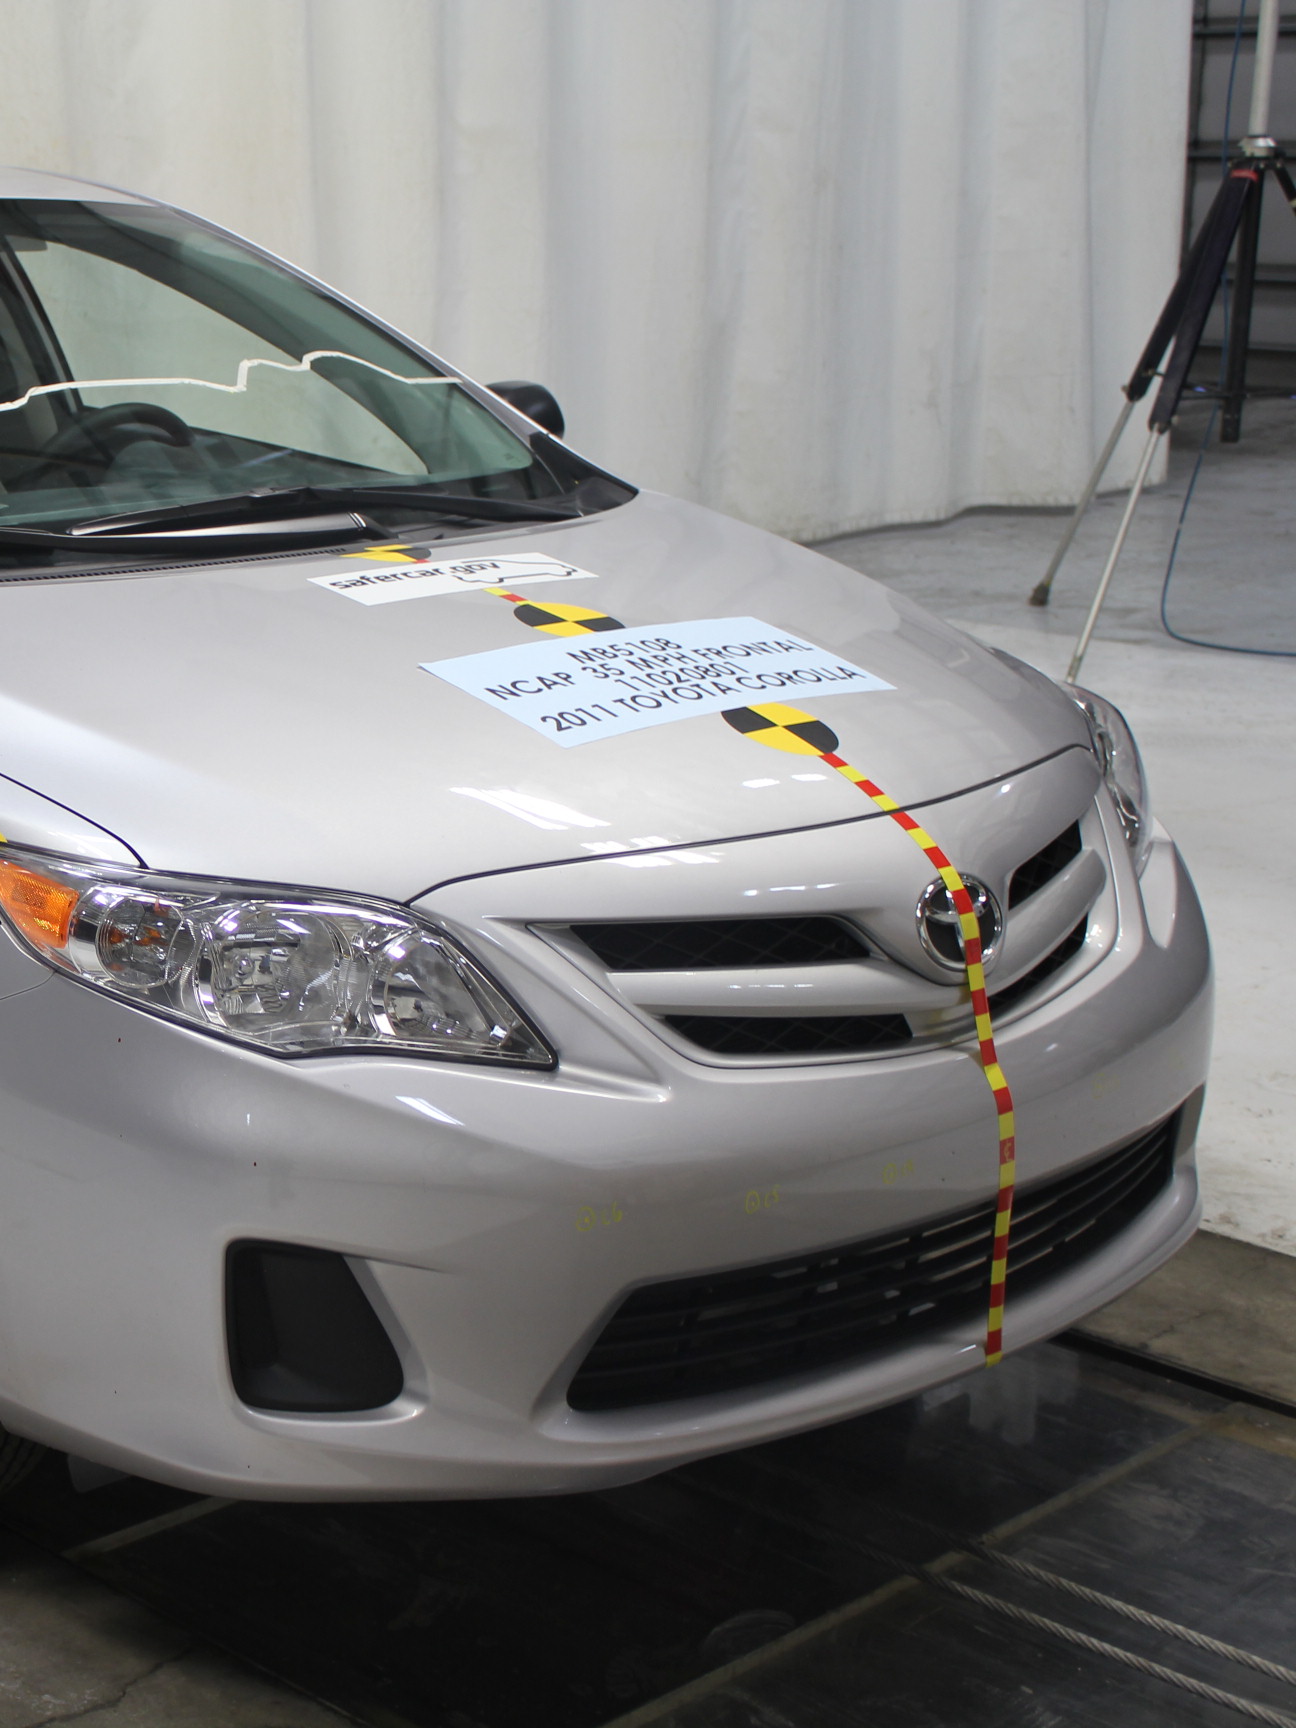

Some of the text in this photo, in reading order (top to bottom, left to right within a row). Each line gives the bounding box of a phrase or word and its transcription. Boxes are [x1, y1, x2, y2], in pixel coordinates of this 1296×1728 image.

[329, 560, 501, 590] safercar.gov
[566, 637, 683, 665] MB5108
[484, 638, 815, 701] NCAP 35 MPH FRONTAL
[614, 661, 750, 693] 11020801
[540, 665, 867, 732] 2011 TOYOTA COROLLA
